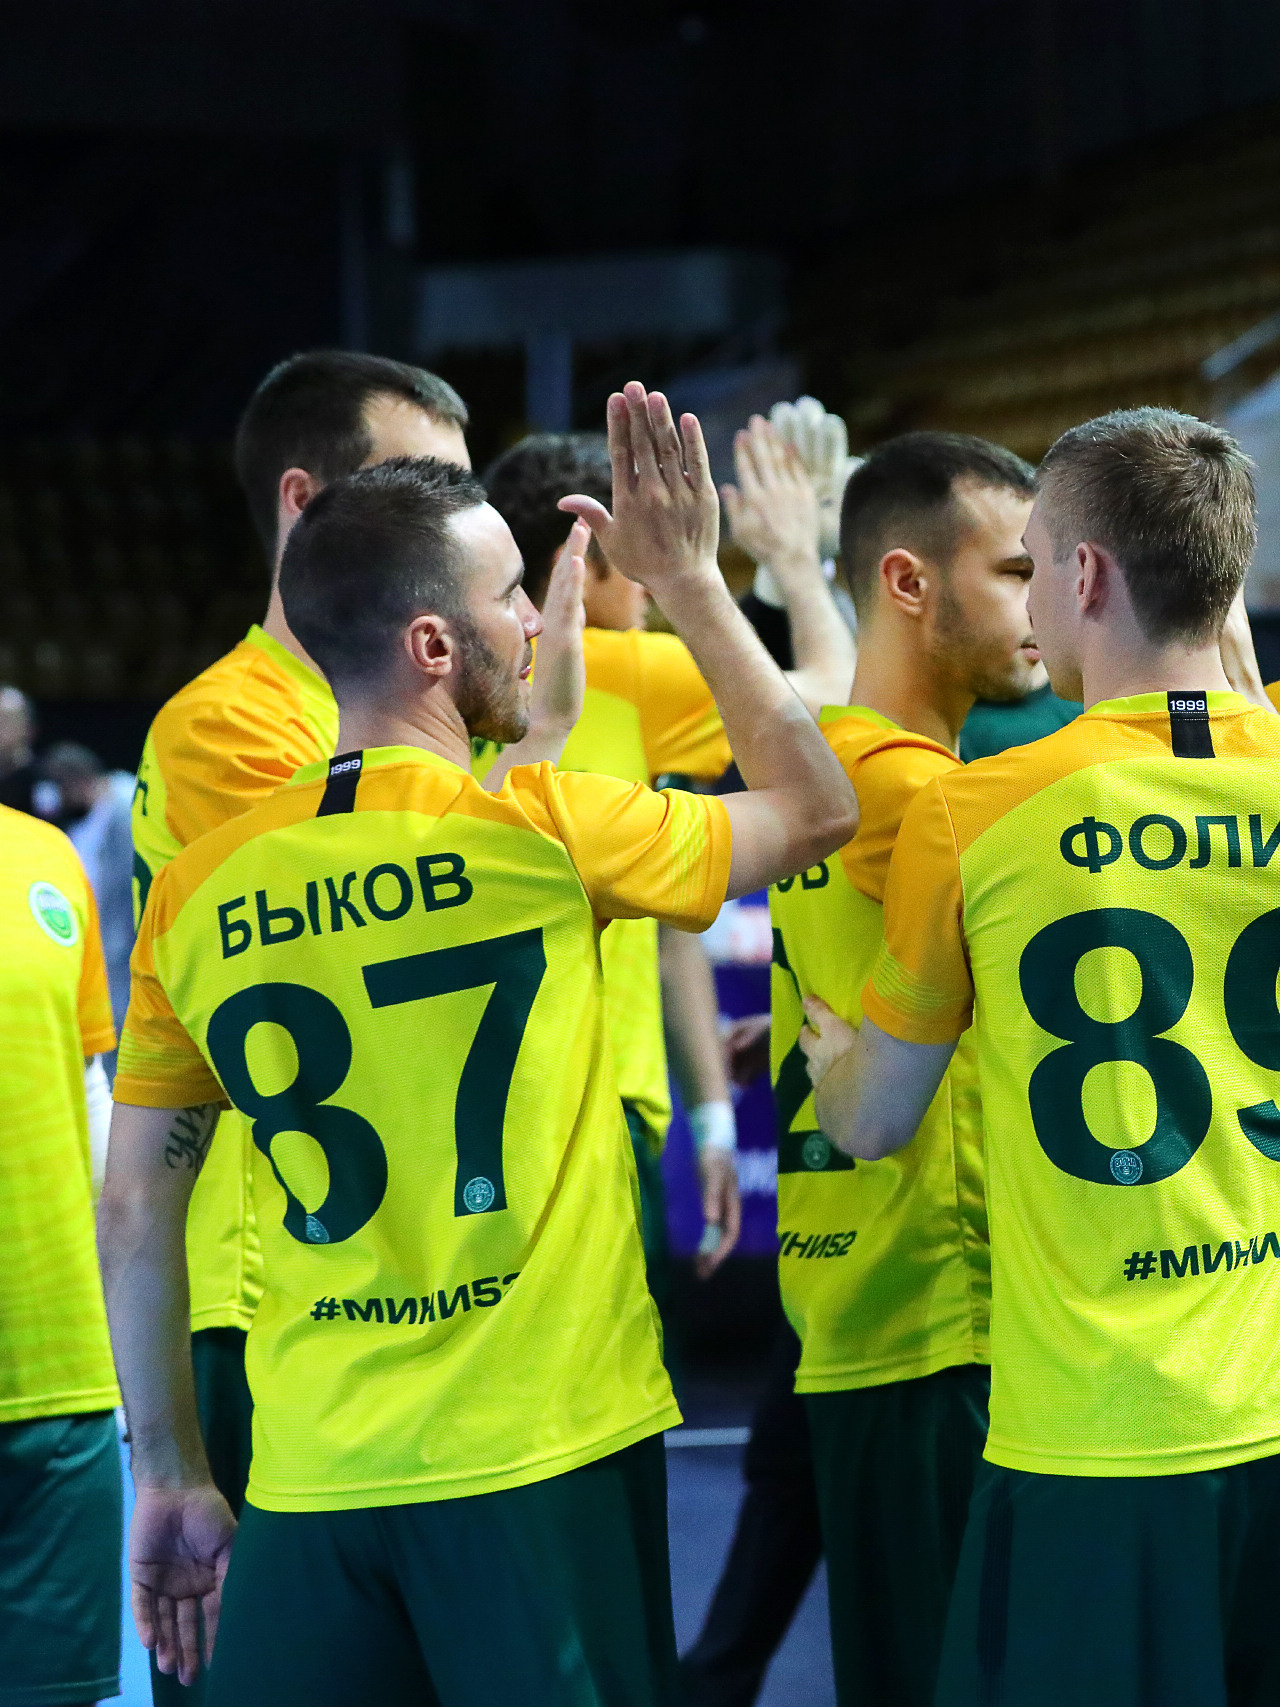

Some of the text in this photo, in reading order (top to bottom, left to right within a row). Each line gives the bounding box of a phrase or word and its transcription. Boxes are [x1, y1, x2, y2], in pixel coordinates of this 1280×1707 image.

[1170, 700, 1205, 711] 1999
[330, 759, 361, 775] 1999
[217, 852, 473, 959] БЫКОВ
[206, 928, 547, 1244] 87
